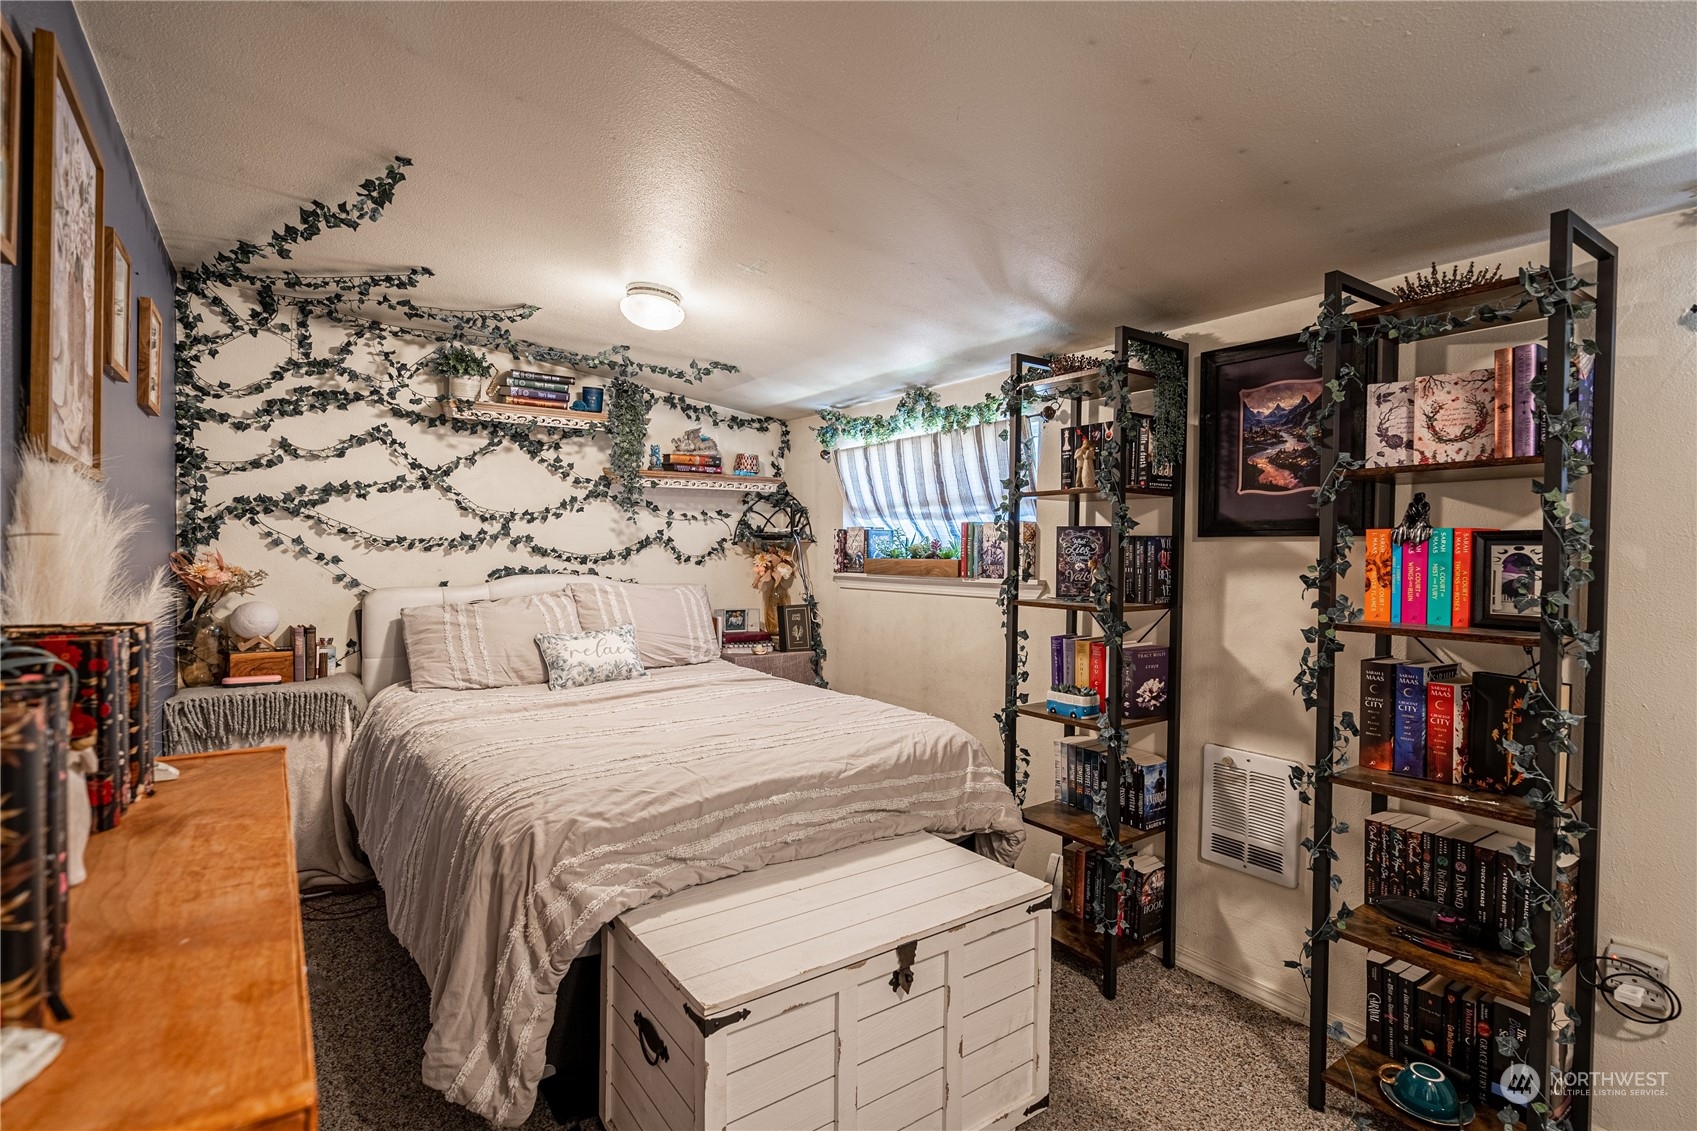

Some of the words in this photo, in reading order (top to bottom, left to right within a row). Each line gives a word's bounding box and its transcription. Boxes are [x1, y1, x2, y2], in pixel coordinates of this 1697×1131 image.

[1065, 570, 1092, 582] Veil
[570, 638, 626, 658] relax
[1364, 700, 1384, 709] CITY
[1430, 718, 1450, 726] CITY
[1437, 868, 1447, 904] RIGHTEOU
[1455, 874, 1466, 909] DAMNED
[1368, 992, 1381, 1023] CARAVAL
[1516, 1028, 1527, 1042] The
[1479, 1038, 1488, 1063] GRACE
